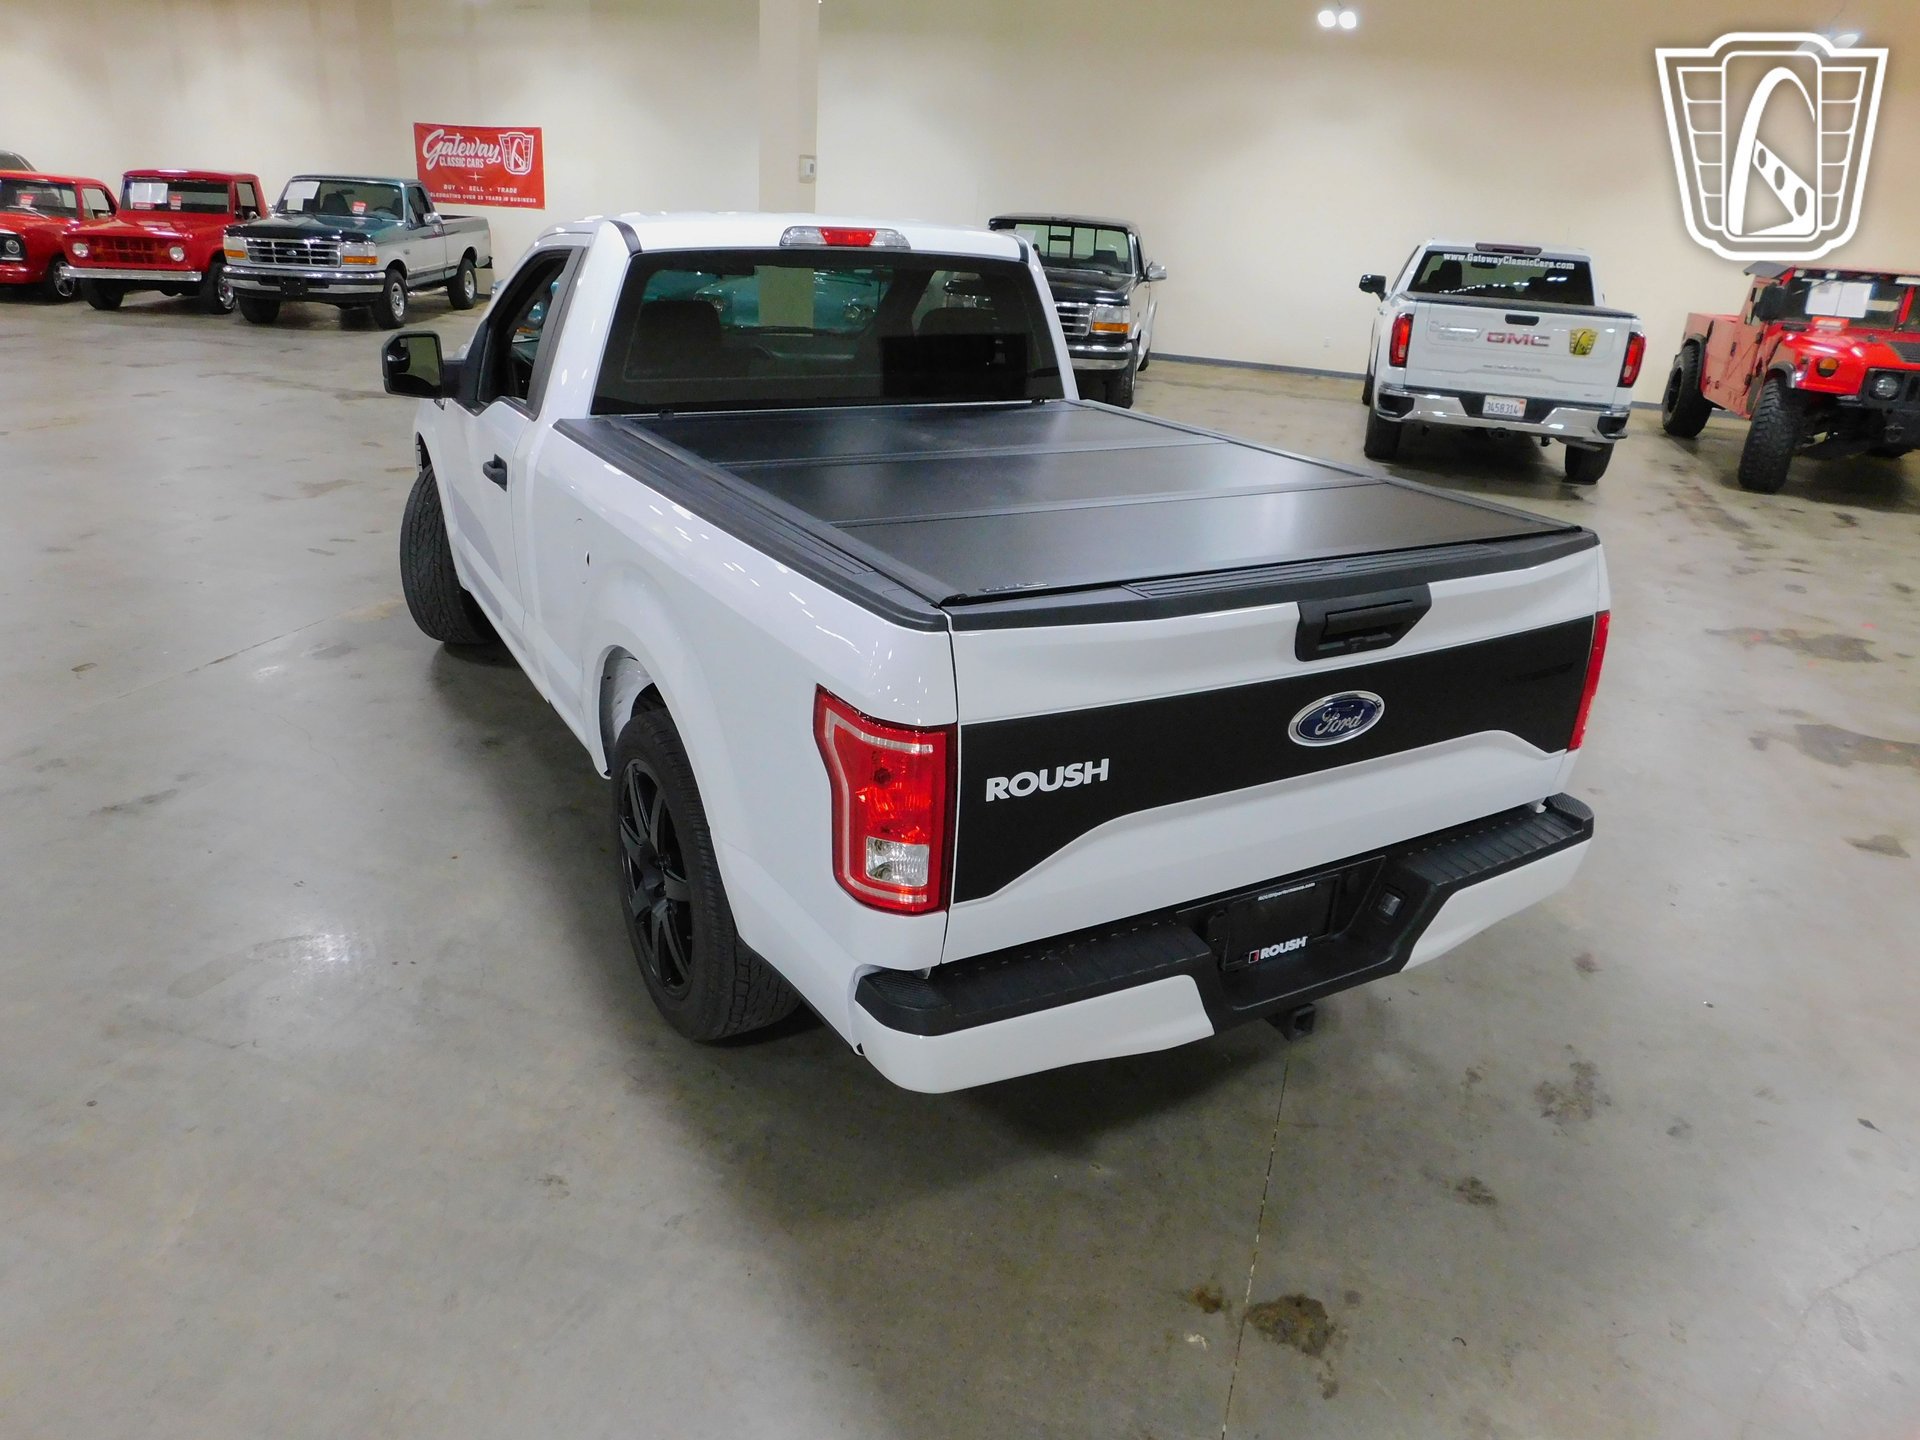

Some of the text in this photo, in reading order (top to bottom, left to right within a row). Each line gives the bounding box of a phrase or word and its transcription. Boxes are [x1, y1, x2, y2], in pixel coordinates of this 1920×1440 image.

[423, 128, 501, 170] Gateway
[439, 156, 484, 168] CLASSIC CARS
[497, 186, 518, 194] TRADE
[1443, 252, 1575, 270] www.GatewayClassicCars.com
[1486, 331, 1551, 347] GMC
[1314, 704, 1364, 736] Ford
[985, 758, 1110, 802] ROUSH
[1260, 936, 1308, 960] ROUSH
